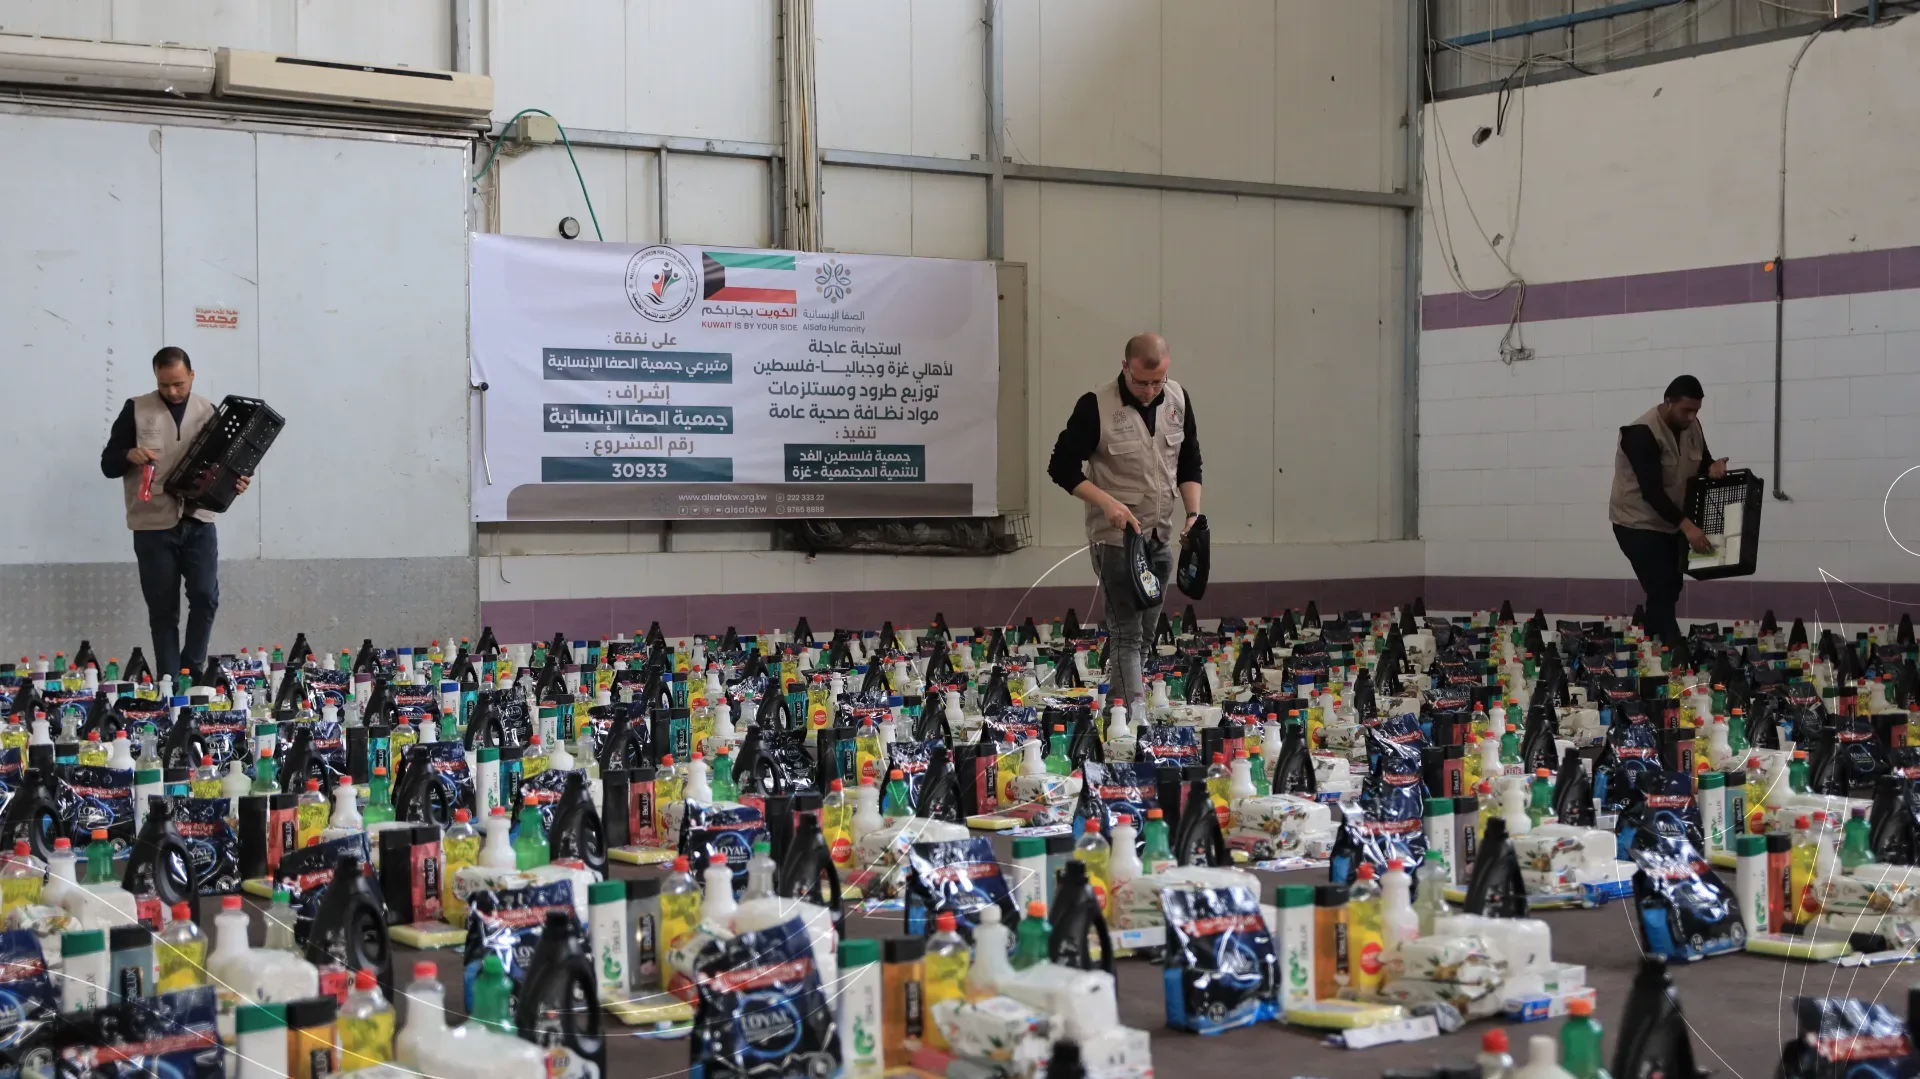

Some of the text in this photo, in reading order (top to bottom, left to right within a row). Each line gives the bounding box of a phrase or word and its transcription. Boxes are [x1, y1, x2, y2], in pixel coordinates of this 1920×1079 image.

[195, 314, 239, 325] محمد
[701, 305, 797, 320] الكويت بجانبكم
[842, 310, 865, 321] الصفا
[701, 321, 732, 329] KUWAIT
[734, 322, 742, 330] IS
[743, 322, 754, 330] BY
[756, 323, 778, 331] YOUR
[802, 323, 866, 335] AlSafa Humanity
[614, 331, 648, 346] نفقة
[652, 332, 677, 349] على
[808, 339, 901, 358] استجابة عاجلة
[548, 354, 728, 377] متبرعي جمعية الصفا الإنسانية
[888, 361, 909, 378] غزة
[912, 361, 953, 383] لأهالي
[616, 383, 670, 405] إشراف
[768, 381, 940, 404] توزيع طرود ومستلزمات
[549, 407, 728, 431] جمعية الصفا الإنسانية
[769, 403, 805, 420] عامة
[809, 404, 850, 424] صحية
[907, 407, 939, 425] مواد
[842, 426, 877, 443] تنفيذ
[593, 434, 663, 457] المشروع
[668, 436, 694, 456] رقم
[800, 450, 911, 465] جمعية فلسطين الغد
[611, 463, 667, 478] 30933
[792, 466, 812, 480] غزة
[821, 466, 878, 481] المجتمعية
[880, 466, 918, 481] للتنمية
[678, 493, 767, 503] www.alsafakw.org.kw
[724, 505, 767, 514] alsafakw
[740, 1009, 789, 1031] LOYAL
